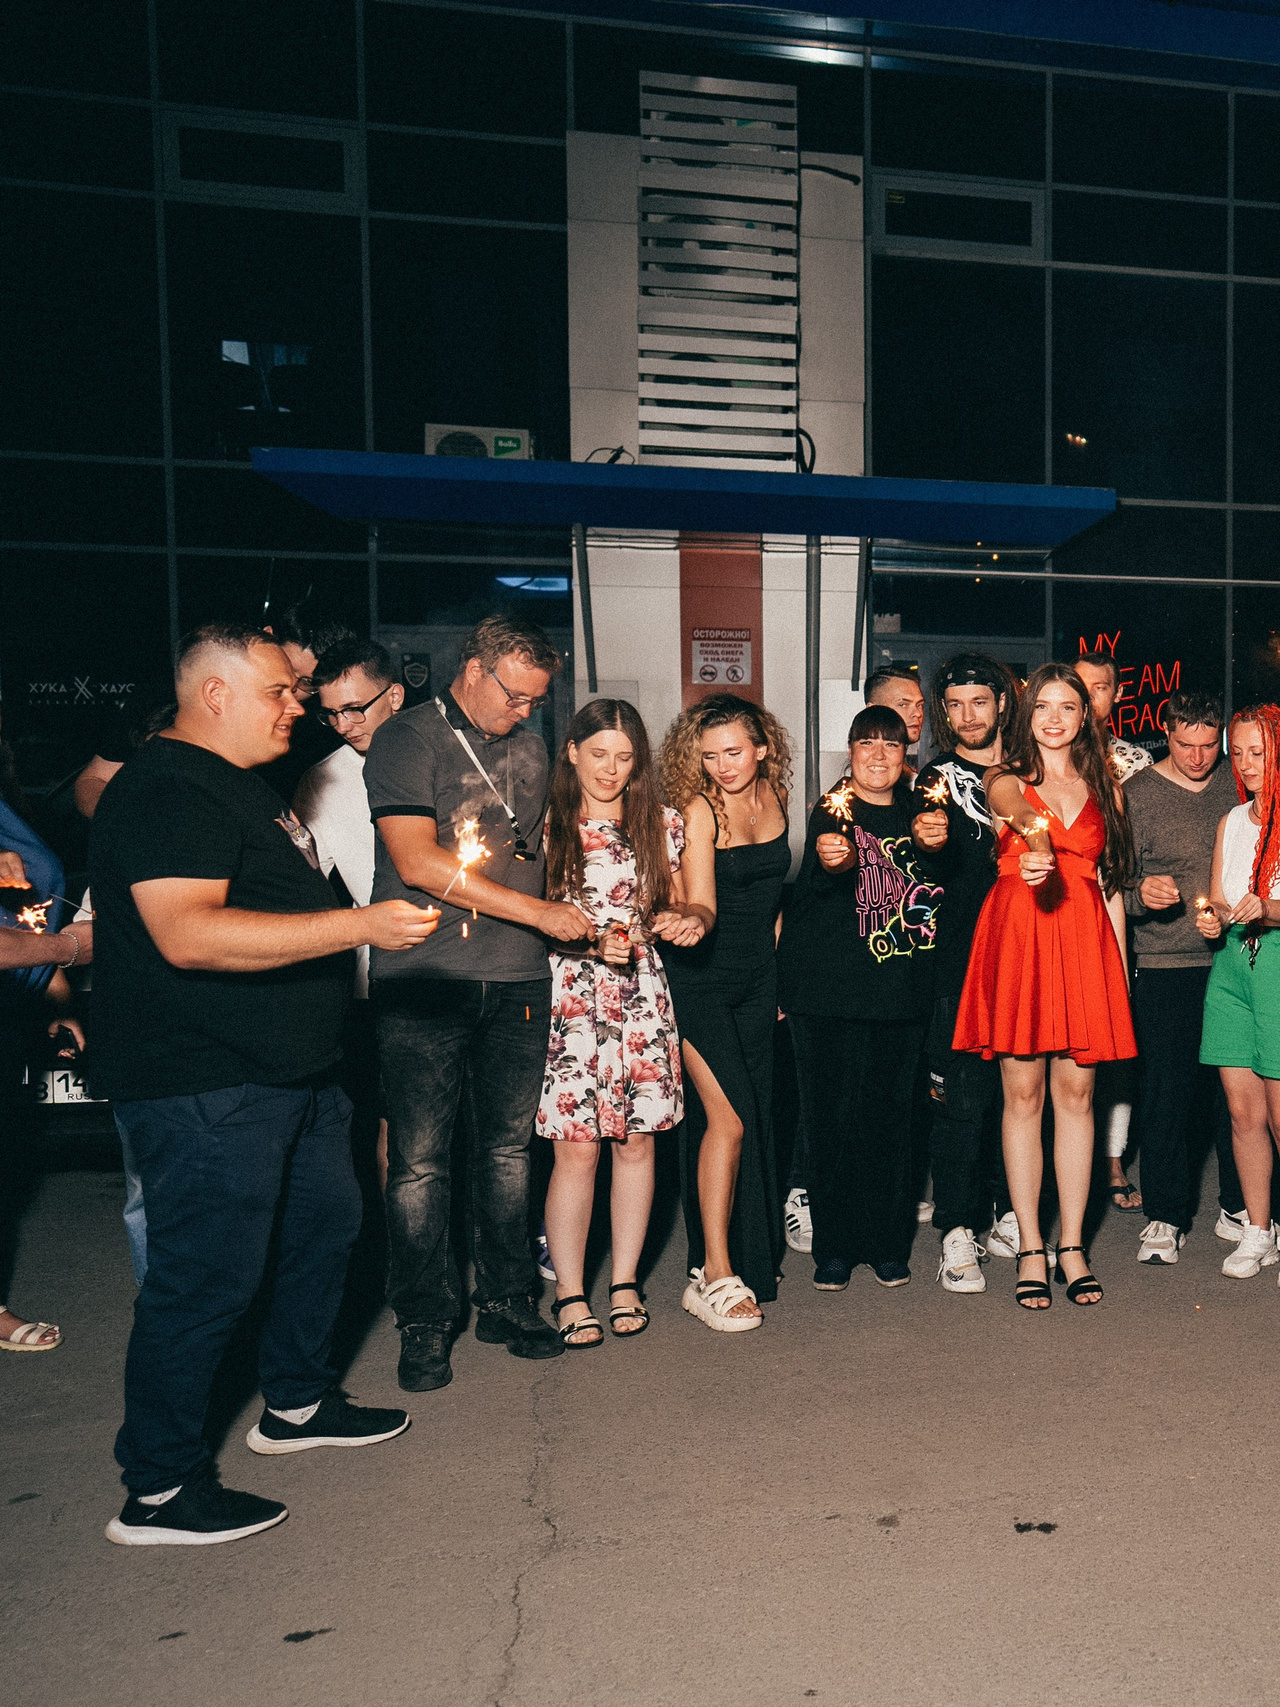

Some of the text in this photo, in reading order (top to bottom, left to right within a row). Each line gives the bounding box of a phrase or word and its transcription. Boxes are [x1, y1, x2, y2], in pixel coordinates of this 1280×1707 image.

[693, 629, 750, 640] ОСТОРОЖНО!
[1079, 630, 1121, 659] MY
[99, 682, 136, 694] ХАУС
[1119, 660, 1181, 701] EAM
